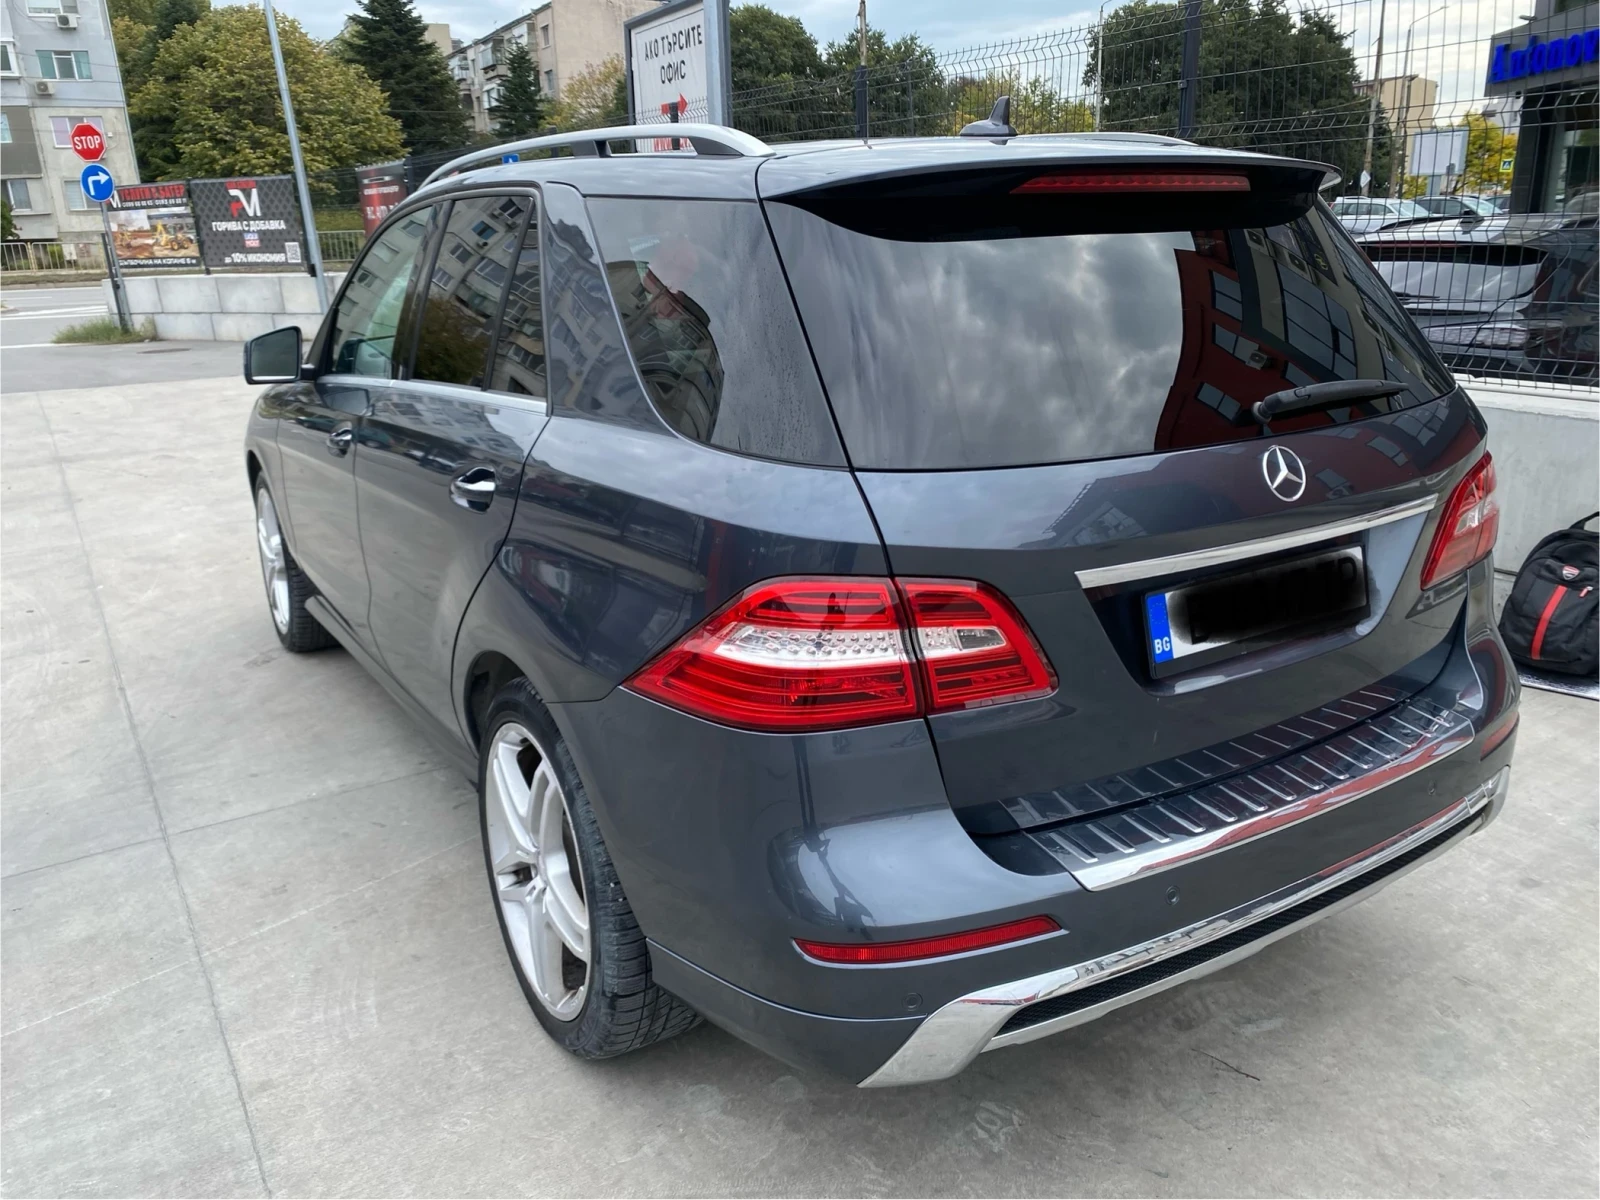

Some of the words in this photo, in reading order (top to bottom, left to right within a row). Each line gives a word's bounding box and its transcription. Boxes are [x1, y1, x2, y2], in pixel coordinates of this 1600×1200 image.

[644, 38, 659, 61] АКО
[661, 24, 703, 56] ТЪРСИТЕ
[660, 59, 686, 84] ОФИС
[73, 135, 101, 150] STOP
[212, 221, 243, 232] ГОРИВА
[243, 220, 249, 230] С
[249, 219, 286, 232] ДОБАВКА
[231, 252, 247, 263] 10%
[247, 252, 286, 263] ИКОНОМИЯ
[1154, 636, 1171, 654] BG
